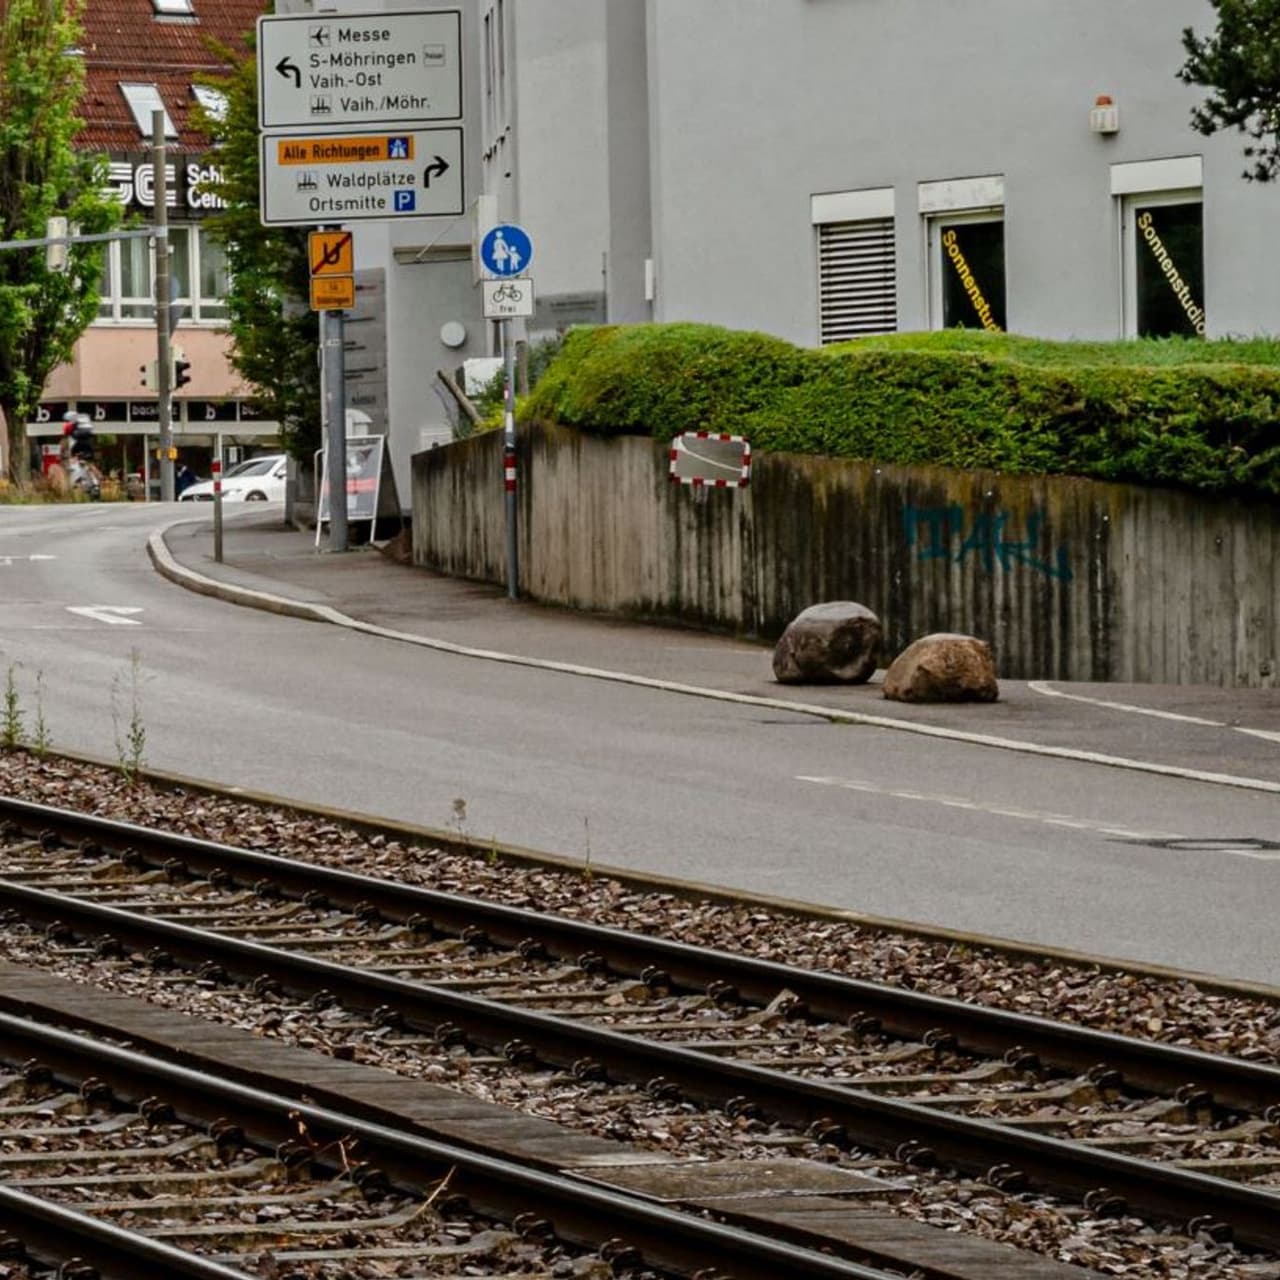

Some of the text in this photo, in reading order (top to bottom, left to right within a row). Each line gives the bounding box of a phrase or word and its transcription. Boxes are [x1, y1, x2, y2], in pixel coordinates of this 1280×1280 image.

[338, 28, 390, 43] Messe
[309, 51, 416, 69] S-Möhringen
[309, 72, 383, 88] Vaih.-Ost
[340, 95, 431, 112] Vaih./Möhr.
[283, 144, 381, 160] Alle Richtungen
[326, 171, 416, 190] Waldplätze
[309, 191, 412, 212] Ortsmitte P
[1138, 212, 1206, 336] Sonnenstudio
